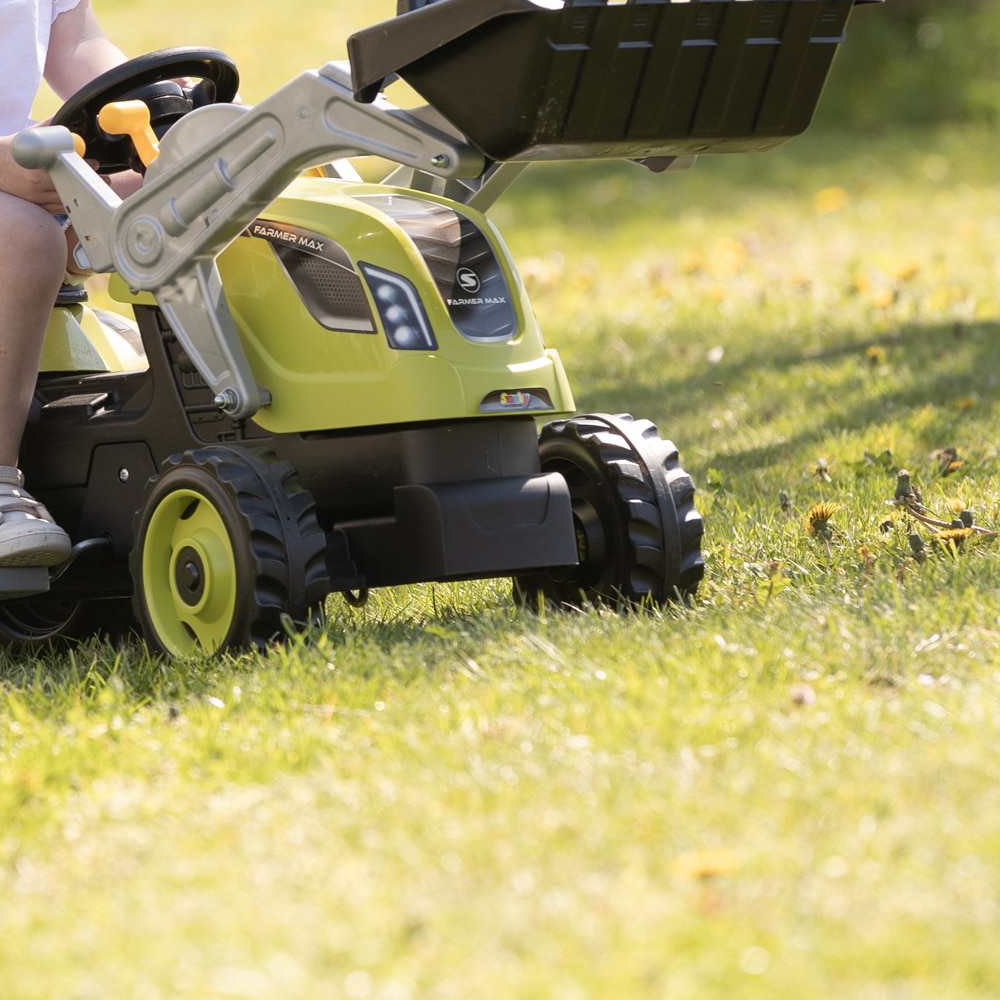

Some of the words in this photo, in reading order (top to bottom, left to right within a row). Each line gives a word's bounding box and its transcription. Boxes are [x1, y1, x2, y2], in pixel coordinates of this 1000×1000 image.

[254, 225, 297, 242] FARMER
[298, 237, 324, 251] MAX
[485, 297, 506, 305] MAX
